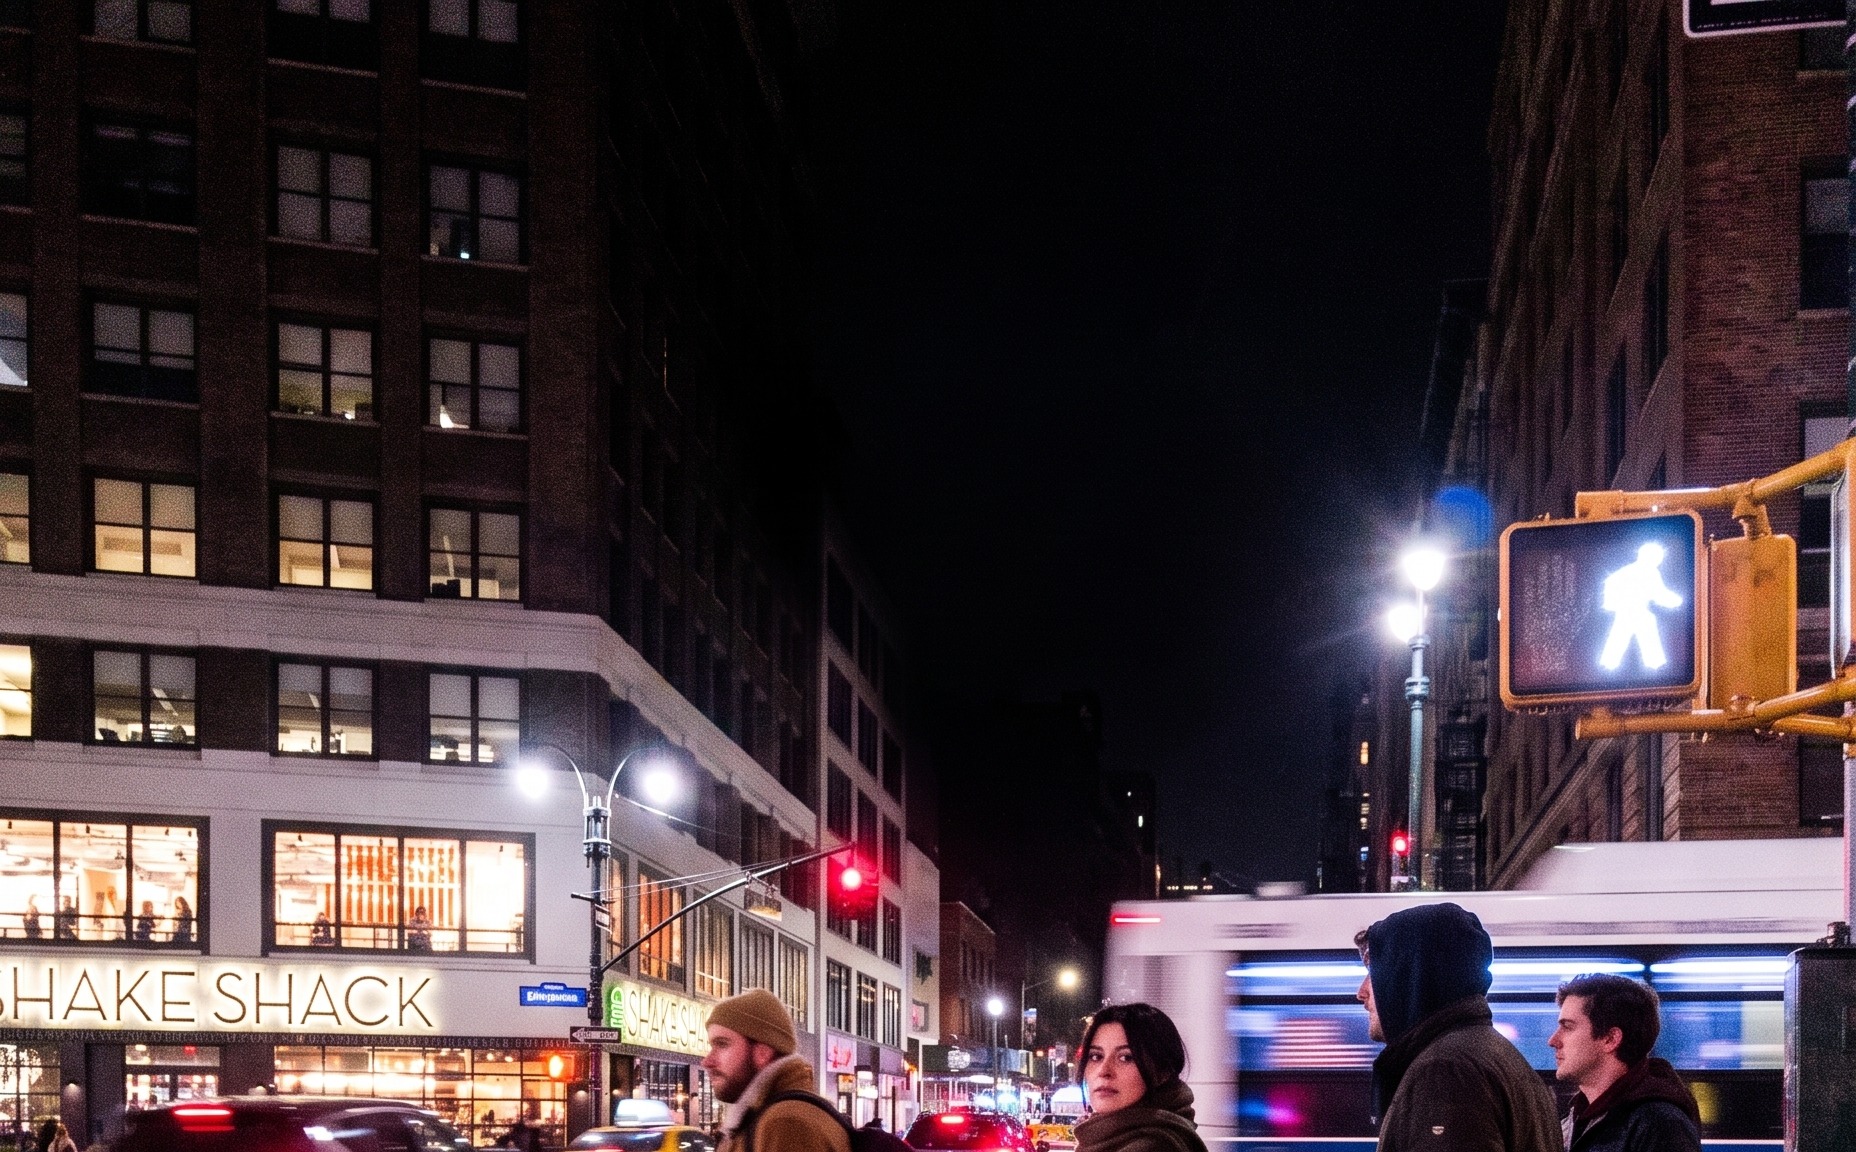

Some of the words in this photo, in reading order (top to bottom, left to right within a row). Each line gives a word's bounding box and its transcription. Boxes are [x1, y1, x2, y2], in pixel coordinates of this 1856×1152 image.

[0, 966, 196, 1022] HAKE
[213, 971, 435, 1028] SHACK
[628, 989, 679, 1045] SHAKE
[680, 1004, 710, 1053] SHA
